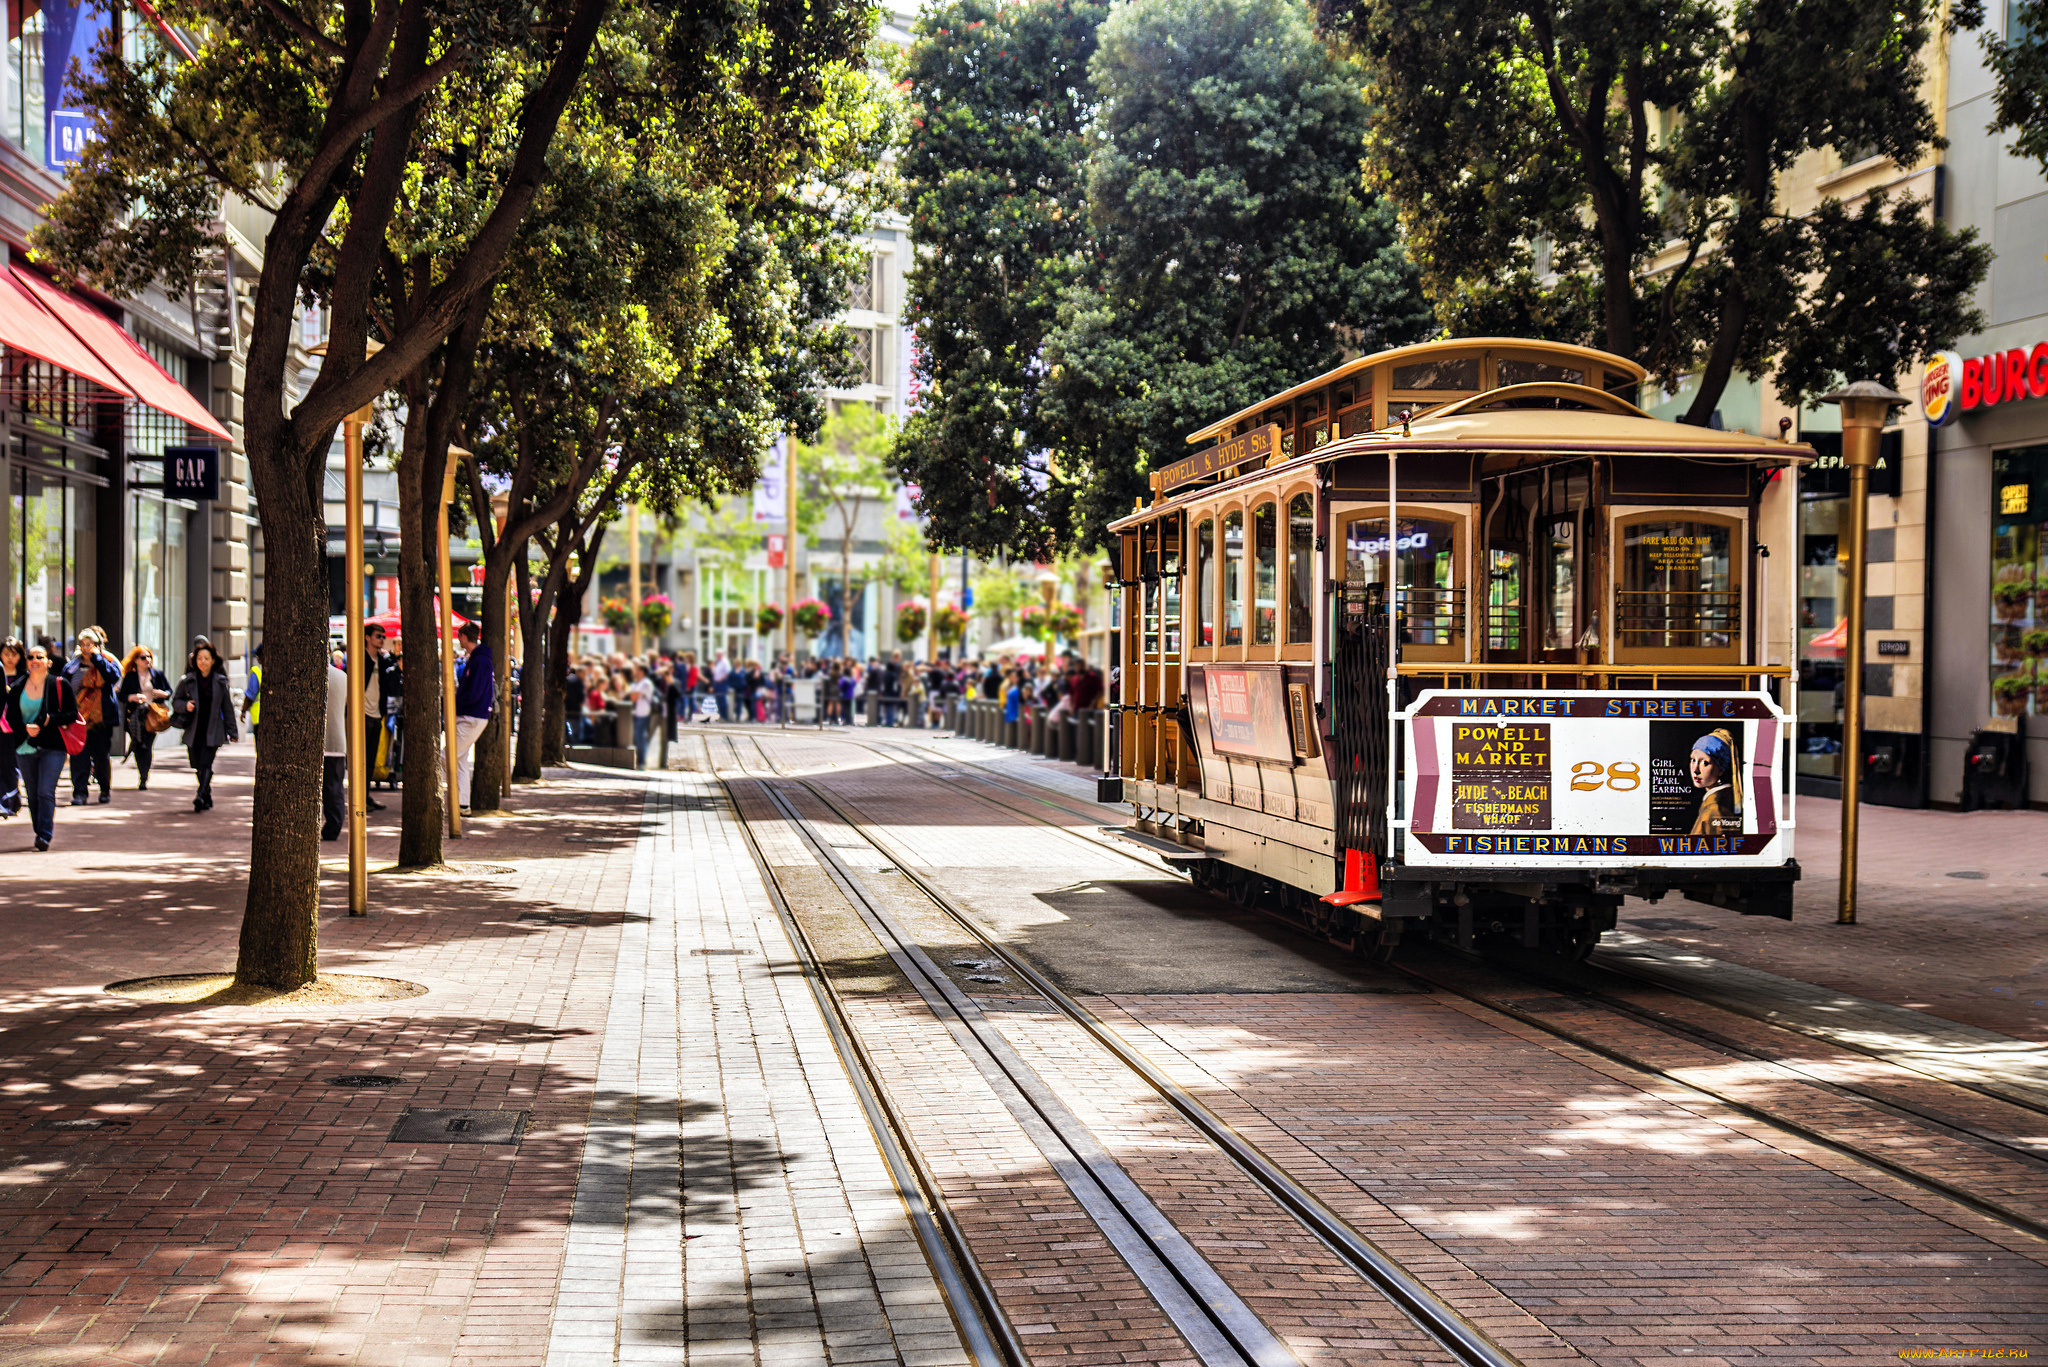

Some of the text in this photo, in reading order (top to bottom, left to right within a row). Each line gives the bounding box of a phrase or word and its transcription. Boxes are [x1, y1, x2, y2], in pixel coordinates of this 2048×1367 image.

[1163, 433, 1269, 486] POWELL & HYDE Sts.
[176, 457, 206, 481] GAP
[2000, 484, 2029, 500] OPEN
[2000, 498, 2028, 515] LATE
[1643, 536, 1660, 545] FARE
[1679, 537, 1695, 545] ONE
[1460, 699, 1575, 716] MARKET
[1605, 700, 1711, 717] STREET
[1458, 728, 1546, 741] POWELL
[1481, 742, 1524, 752] AND
[1457, 752, 1547, 765] MARKET
[1571, 761, 1640, 791] 28
[1677, 768, 1684, 776] A
[1652, 776, 1680, 785] PEARL
[1457, 785, 1548, 800] HYDE AND BEACH
[1652, 785, 1692, 794] EARRING
[1228, 786, 1257, 808] FANCISCO
[1259, 792, 1288, 815] NICIPAL
[1292, 800, 1317, 823] ILWAY
[1465, 803, 1540, 814] FISHERMANS
[1483, 814, 1522, 825] WHARF
[1445, 836, 1745, 854] FISHERMANS WHARF
